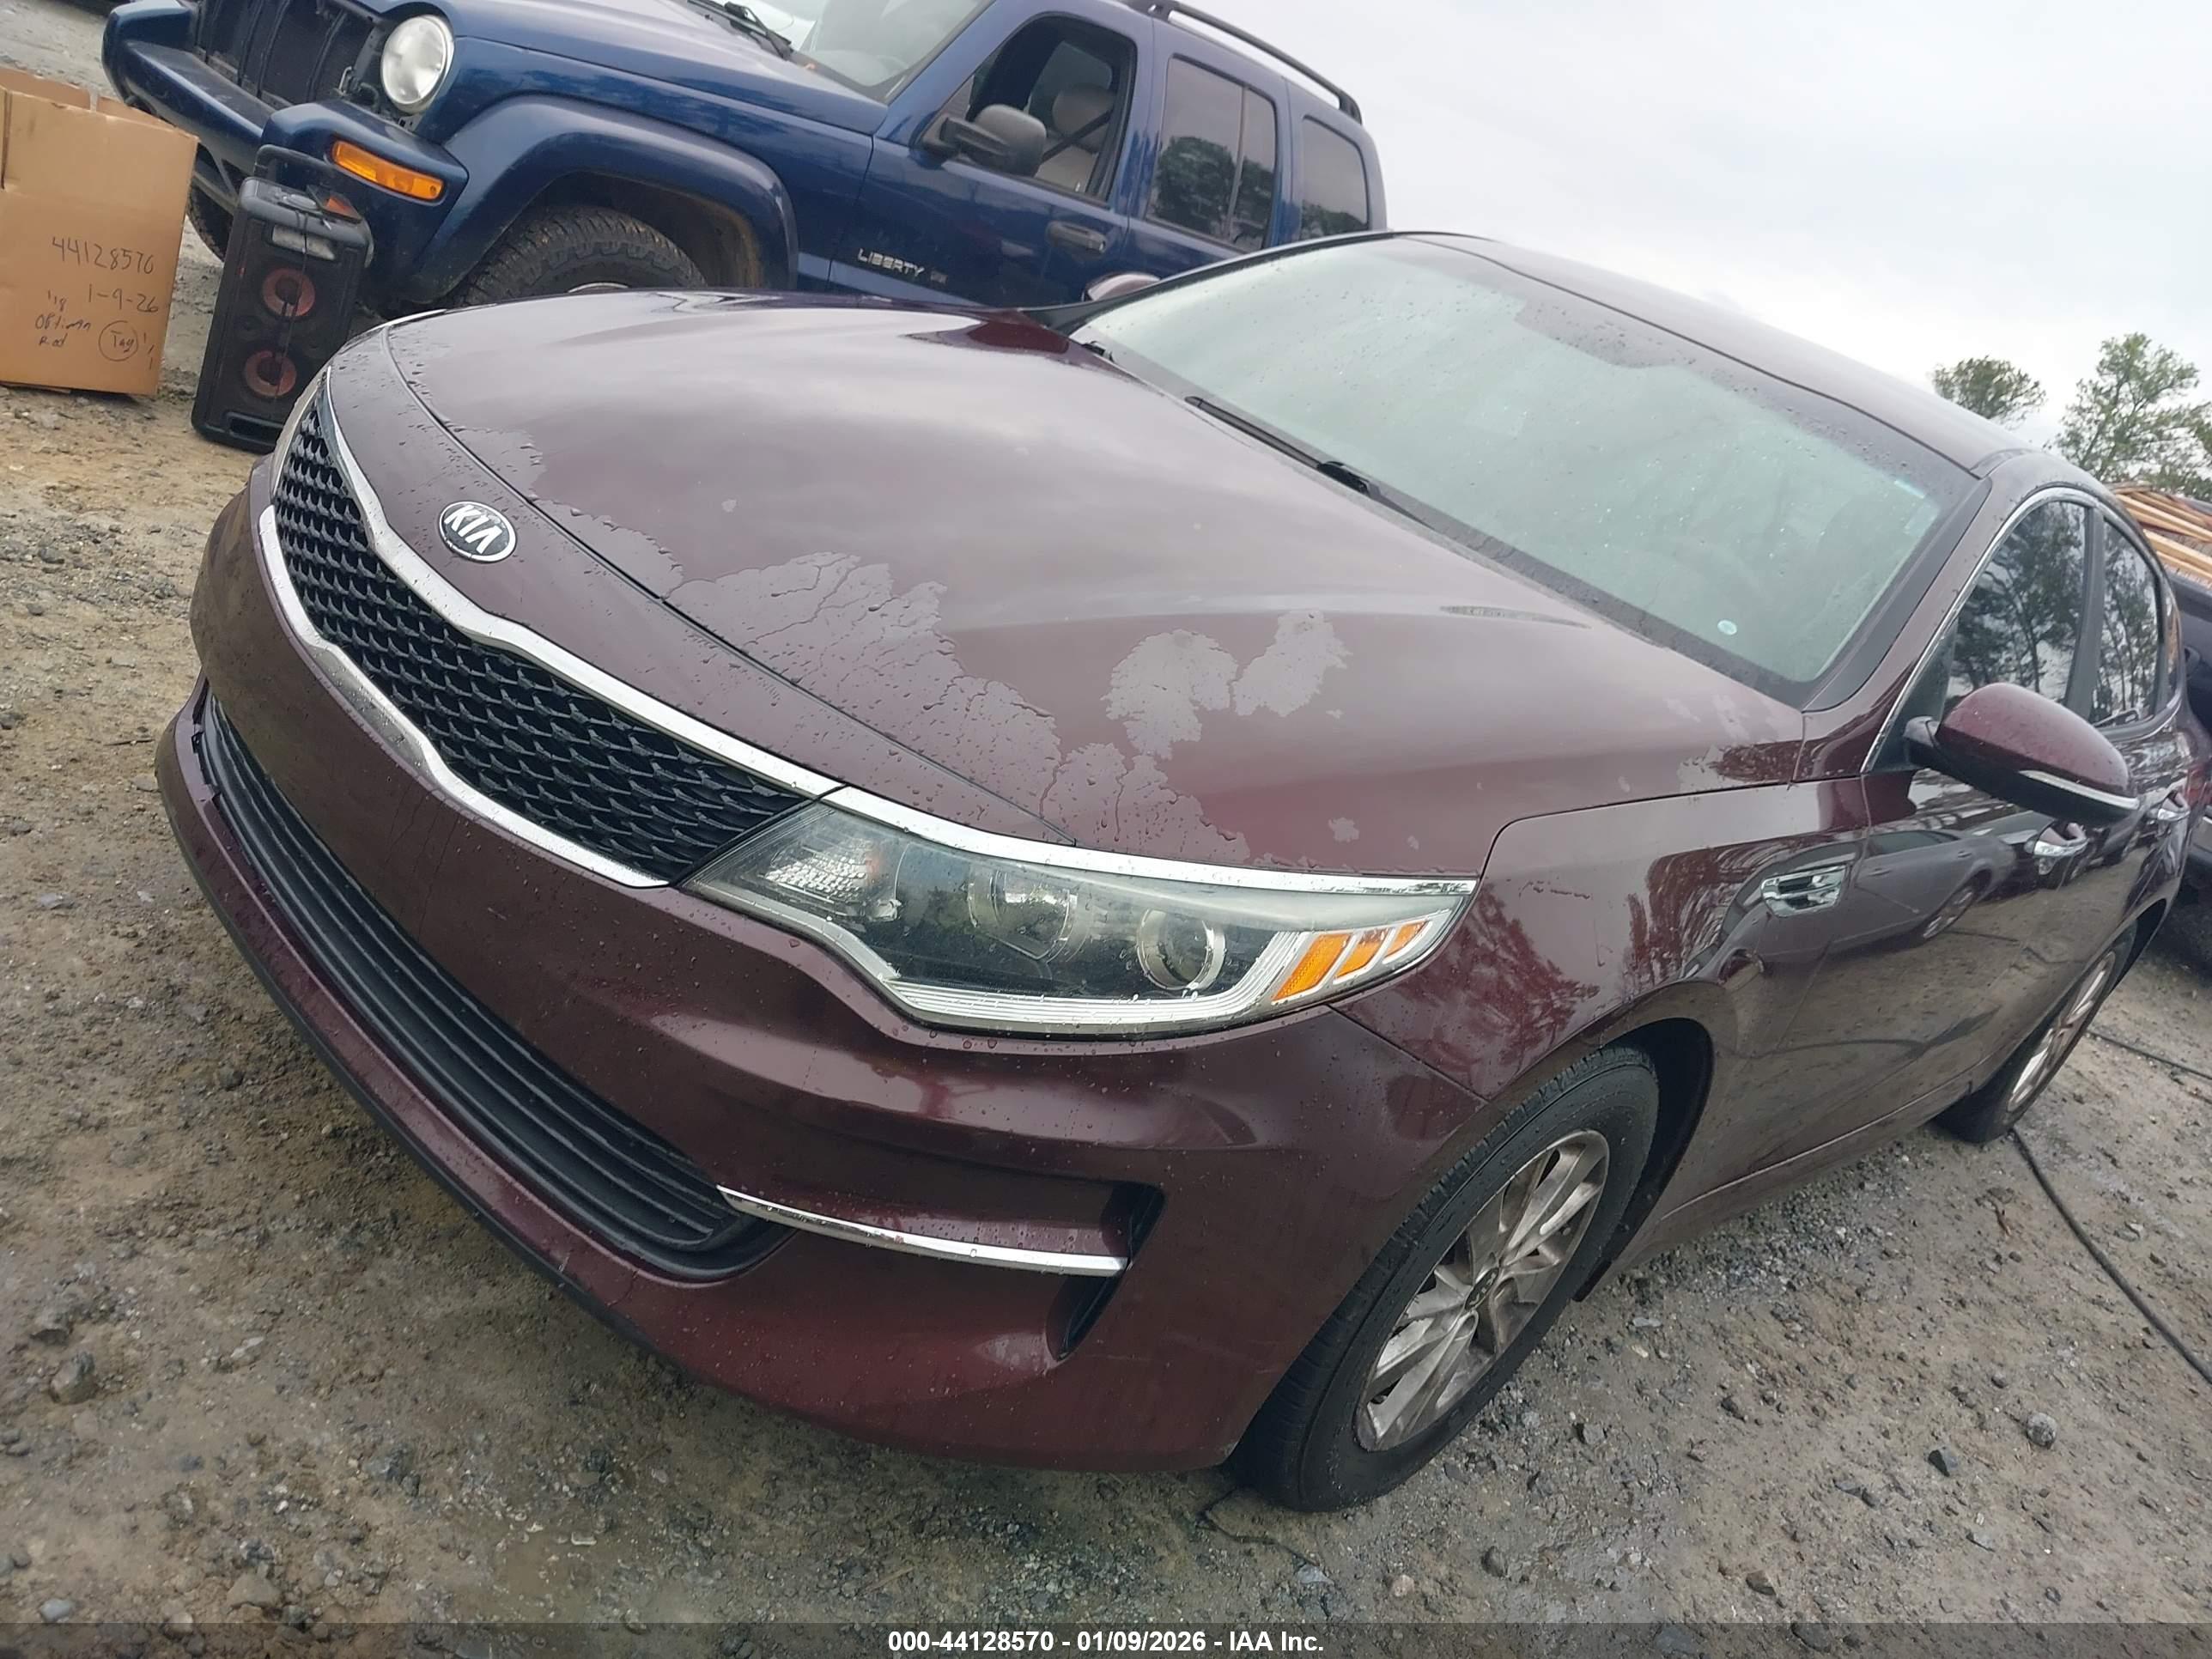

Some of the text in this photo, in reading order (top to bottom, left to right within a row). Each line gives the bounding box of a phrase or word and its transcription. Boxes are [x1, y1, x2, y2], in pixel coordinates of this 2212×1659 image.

[857, 247, 925, 277] LIBERTY
[88, 283, 160, 313] 1-9-26
[443, 504, 503, 555] KIA
